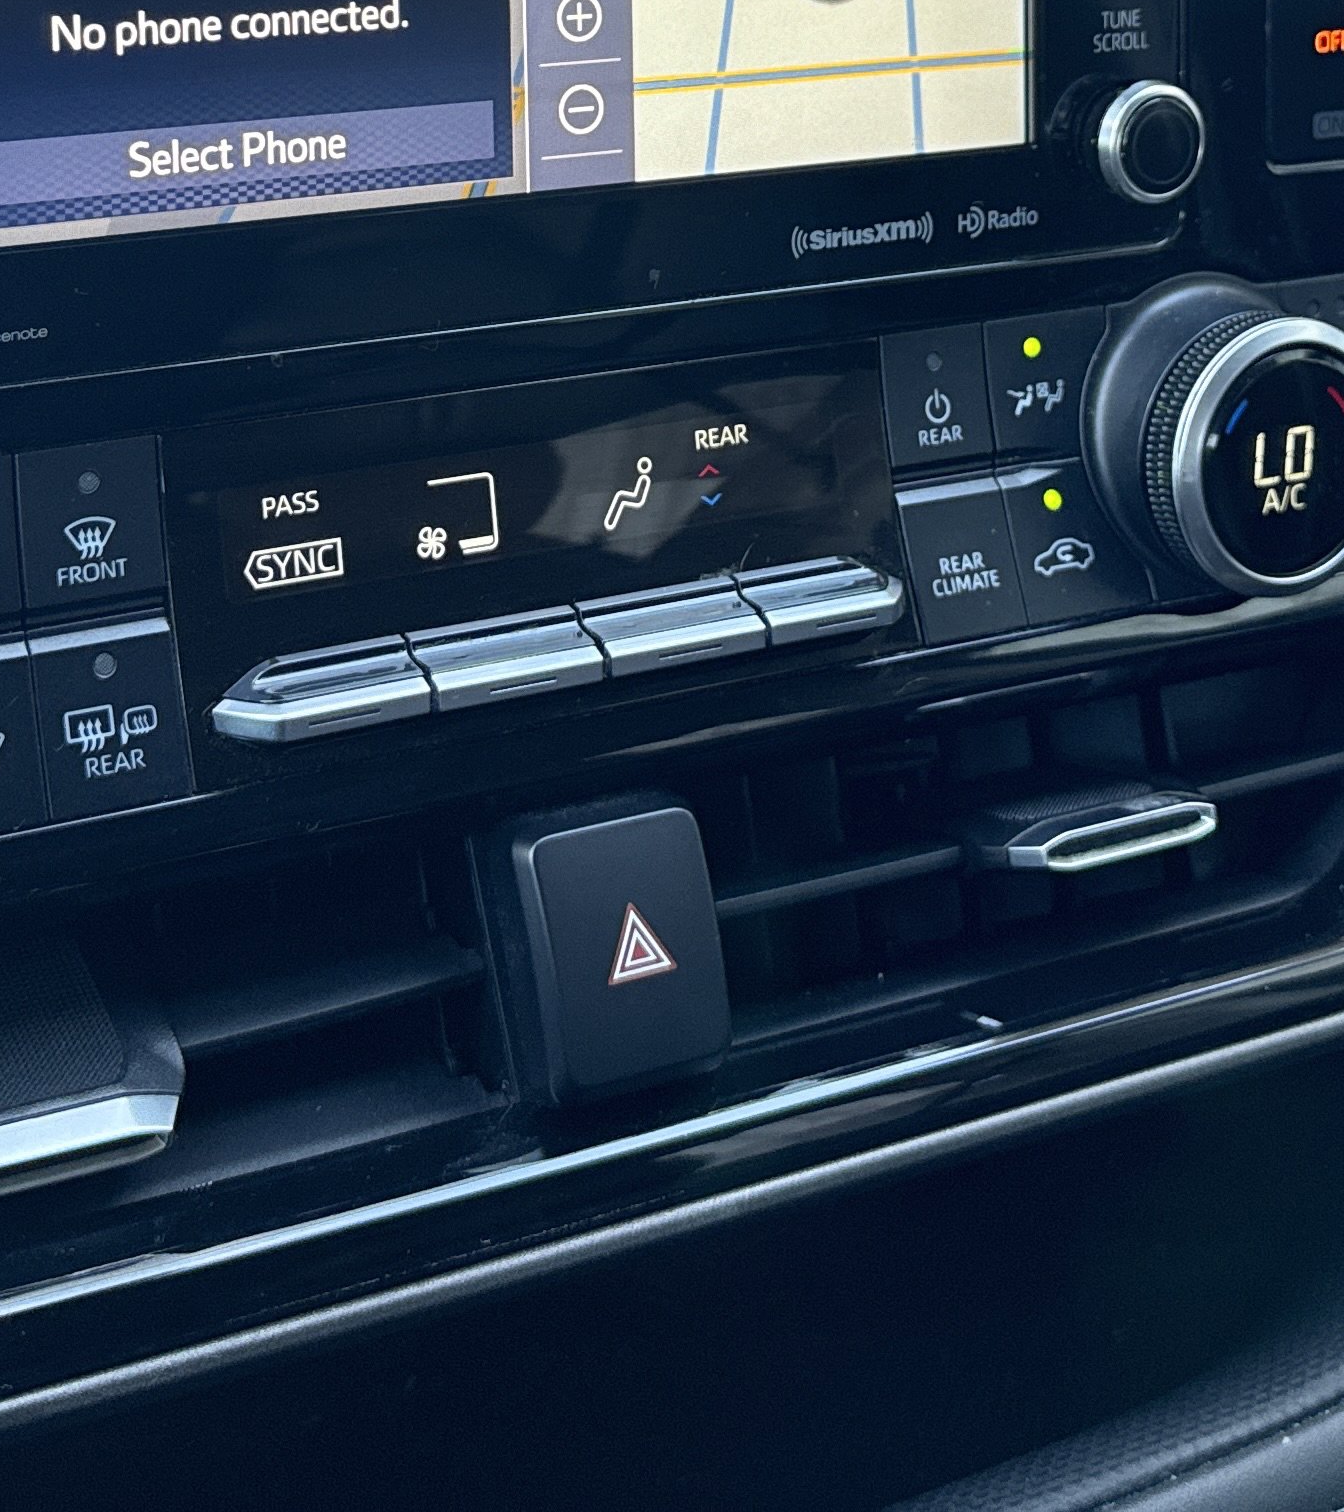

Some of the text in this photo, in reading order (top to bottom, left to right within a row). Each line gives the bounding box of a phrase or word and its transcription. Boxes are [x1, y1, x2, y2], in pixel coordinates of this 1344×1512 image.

[50, 14, 105, 53] No
[116, 11, 222, 55] phone
[1101, 8, 1142, 29] TUNE
[1093, 31, 1149, 54] SCROLL
[129, 132, 347, 179] Select Phone
[988, 207, 1039, 230] Radio
[694, 423, 749, 451] REAR
[918, 422, 963, 446] REAR
[1253, 424, 1316, 489] LO
[261, 490, 320, 520] PASS
[1261, 484, 1308, 515] A/C
[57, 557, 128, 587] FRONT
[255, 544, 339, 583] SYNC
[938, 551, 984, 578] REAR
[932, 567, 1001, 599] CLIMATE
[85, 747, 147, 780] REAR
